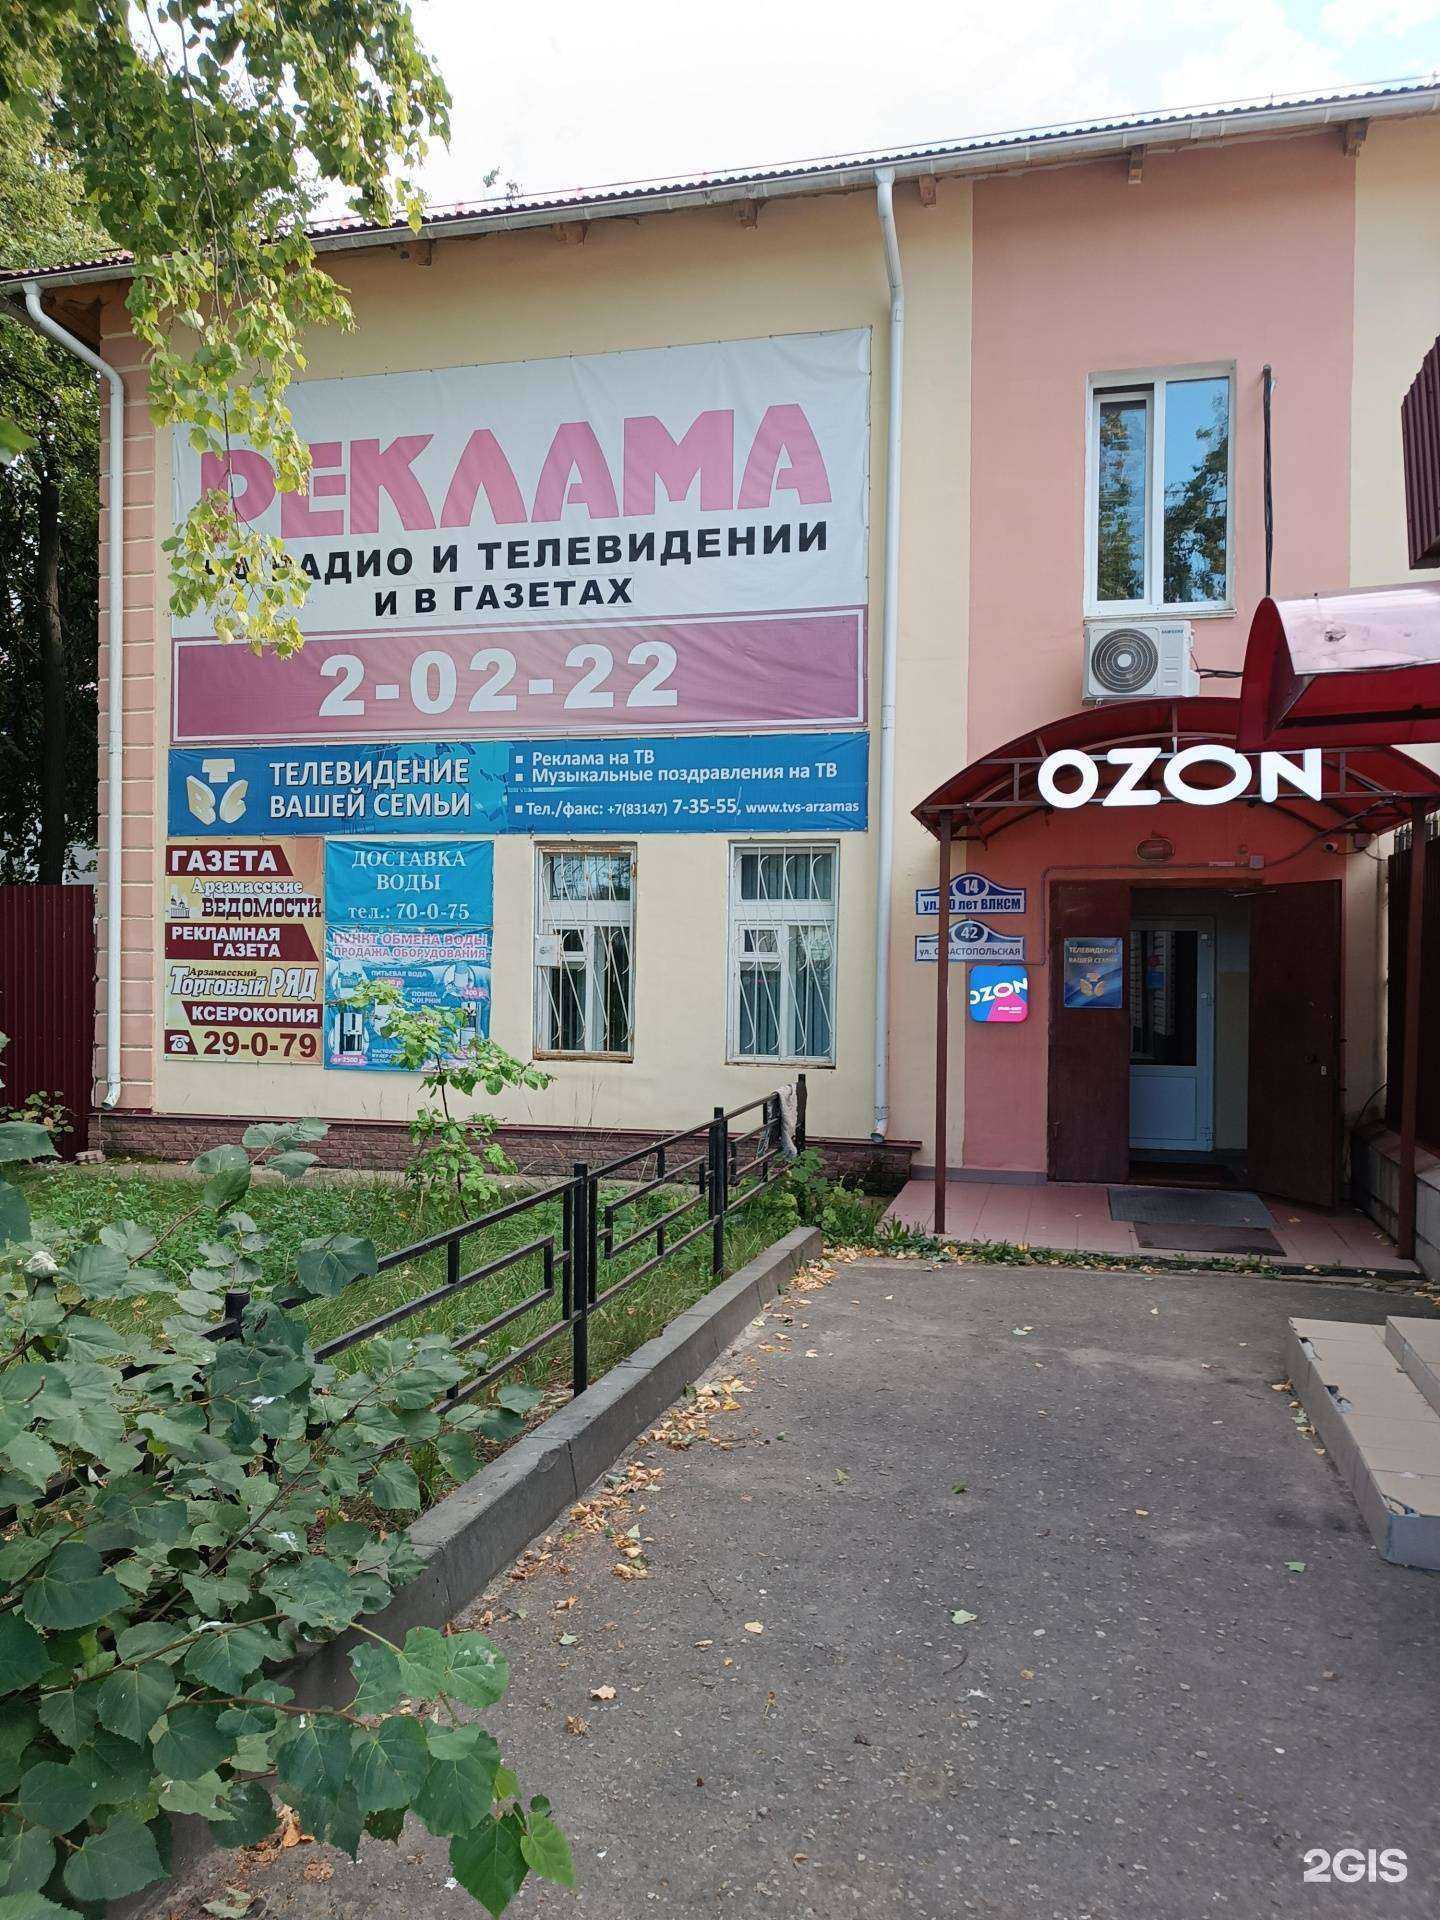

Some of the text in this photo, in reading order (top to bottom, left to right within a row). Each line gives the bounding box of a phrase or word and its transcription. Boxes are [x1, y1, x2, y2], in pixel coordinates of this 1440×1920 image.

[200, 403, 833, 543] РЕКЛАМА
[433, 543, 459, 573] И
[477, 521, 828, 571] ТЕЛЕВИДЕНИИ
[375, 577, 634, 617] И В ГАЗЕТАХ
[318, 640, 679, 718] 2-02-22
[532, 750, 655, 766] Реклама на ТВ
[269, 758, 470, 790] ТЕЛЕВИДЕНИЕ
[532, 763, 838, 786] Музыкальные поздравления на ТВ
[1037, 744, 1322, 809] OZON
[269, 788, 471, 819] ВАШЕЙ СЕМЬИ
[526, 799, 860, 818] Тел./факс: +7(83147) 7-35-55, www.tvs-arzamas
[171, 850, 278, 872] ГАЗЕТА
[351, 850, 467, 869] ДОСТАВКА
[192, 876, 304, 896] Арзамасские
[376, 873, 441, 893] ВОДЫ
[963, 879, 979, 894] 14
[201, 897, 322, 920] ВЕДОМОСТИ
[348, 903, 470, 920] тел.: 70-0-75
[923, 901, 939, 911] ул.
[958, 900, 978, 910] лет
[981, 899, 1021, 910] ВЛКСМ
[171, 926, 281, 941] РЕКЛАМНАЯ
[333, 932, 488, 948] ПУНКТ ОБМЕНА ВОДЫ
[960, 926, 978, 939] 42
[213, 943, 281, 958] ГАЗЕТА
[333, 946, 487, 959] ПРОДАЖА ОБОРУДОВАНИЯ
[934, 947, 1021, 956] САСТОПОЛЬСКАЯ
[188, 967, 257, 978] Арзамасский
[170, 965, 320, 1002] Торговый РЯД
[969, 977, 1029, 1006] OZON
[192, 1005, 319, 1023] КСЕРОКОПИЯ
[203, 1030, 317, 1058] 29-0-79
